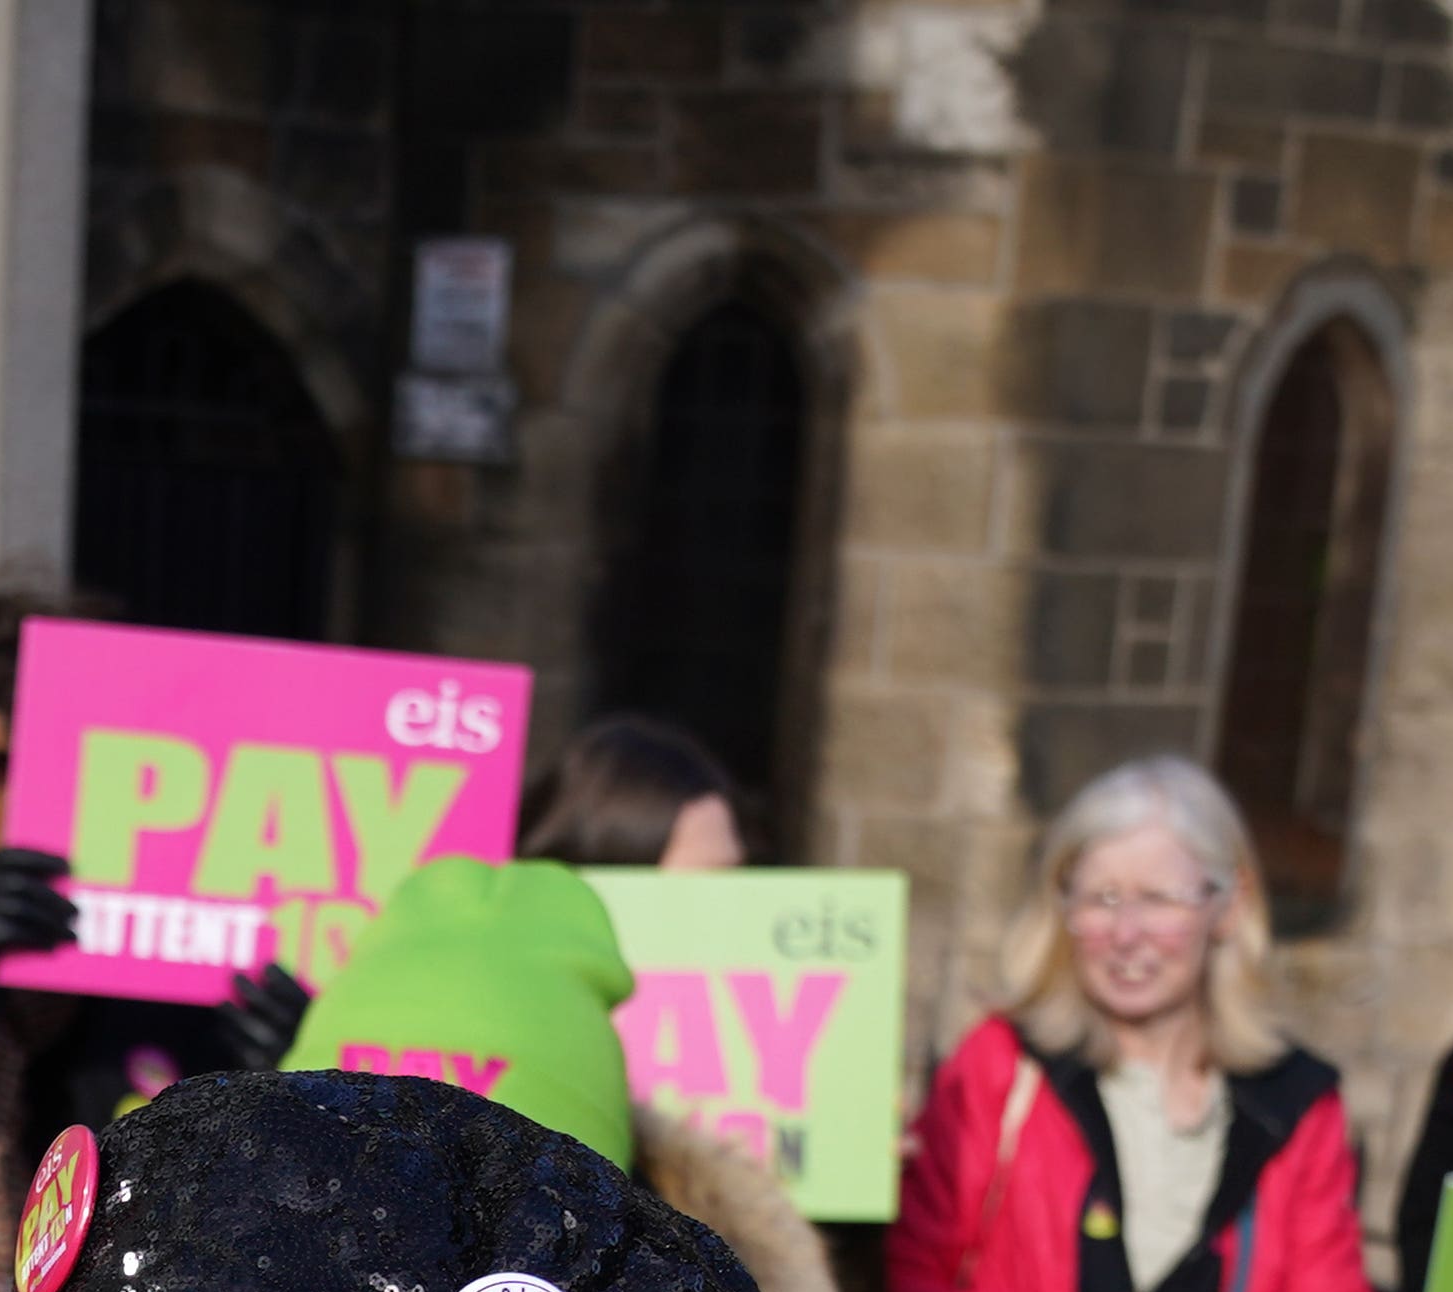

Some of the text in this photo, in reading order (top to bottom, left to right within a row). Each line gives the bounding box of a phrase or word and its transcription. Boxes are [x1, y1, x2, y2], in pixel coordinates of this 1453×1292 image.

[386, 681, 502, 754] eis
[71, 728, 470, 901] PAY
[771, 894, 878, 962] eis
[615, 971, 850, 1113] AY
[20, 1151, 81, 1264] PAY
[36, 1144, 63, 1194] eis
